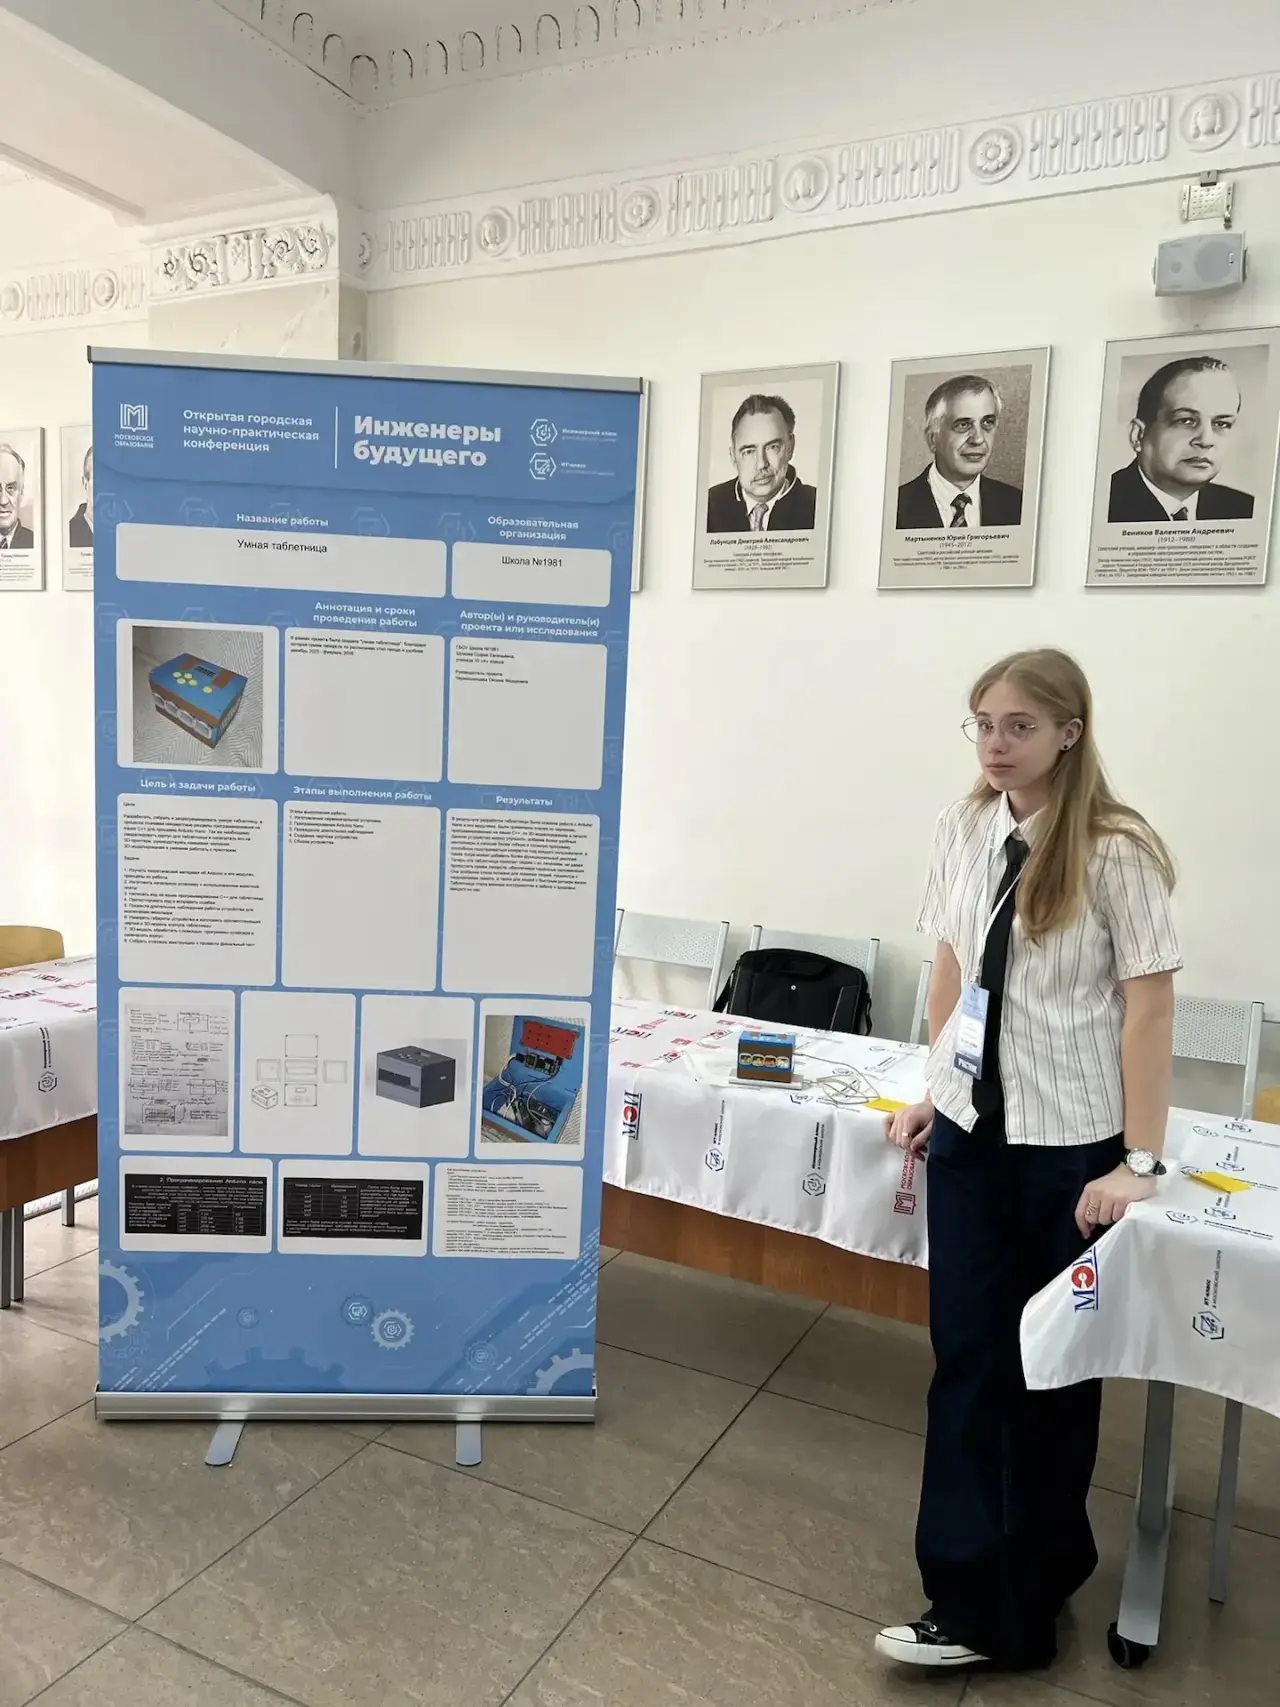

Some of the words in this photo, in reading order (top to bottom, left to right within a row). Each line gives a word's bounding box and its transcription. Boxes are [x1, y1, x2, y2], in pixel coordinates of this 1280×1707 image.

[183, 410, 244, 422] Открытая
[248, 413, 312, 426] городская
[183, 424, 319, 441] научно-практическая
[354, 416, 501, 444] Инженеры
[183, 439, 270, 452] конференция
[353, 439, 487, 467] будущего
[236, 513, 288, 525] Название
[290, 517, 329, 527] работы
[488, 516, 578, 529] Образовательная
[500, 530, 566, 540] организация
[946, 534, 966, 542] Юрий
[967, 533, 1010, 541] Григорьевич
[1155, 528, 1191, 536] Валентин
[237, 539, 269, 549] Умная
[271, 542, 328, 553] таблетница
[710, 538, 736, 546] Лабунцов
[764, 536, 809, 544] Александрович
[502, 556, 530, 565] Школа
[532, 558, 562, 566] №1981
[315, 602, 372, 613] Аннотация
[384, 607, 415, 616] сроки
[313, 614, 376, 625] проведения
[379, 616, 417, 627] работы
[460, 610, 505, 622] Автор(ы)
[516, 615, 600, 627] руководитель(и)
[461, 623, 502, 632] проекта
[526, 627, 598, 637] исследования
[140, 779, 167, 788] Цель
[178, 782, 215, 792] задачи
[217, 783, 256, 793] работы
[293, 786, 325, 795] Этапы
[328, 788, 392, 798] выполнения
[395, 792, 432, 800] работы
[496, 796, 553, 806] Результаты
[901, 1150, 909, 1189] МОСКОВСКО
